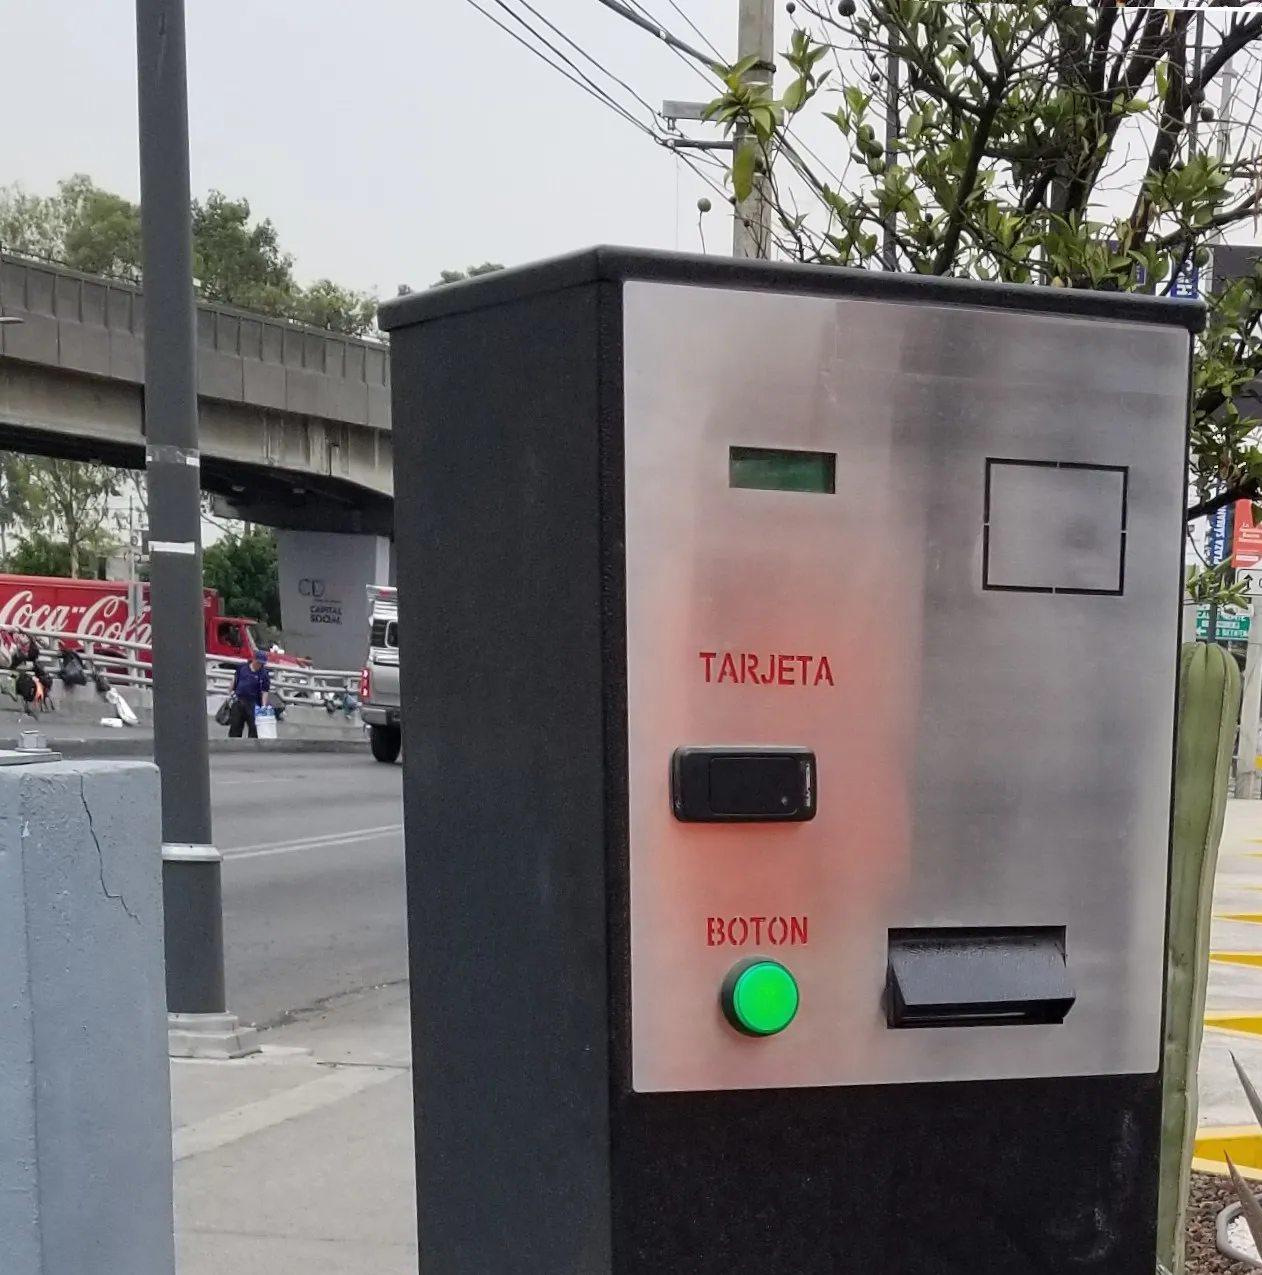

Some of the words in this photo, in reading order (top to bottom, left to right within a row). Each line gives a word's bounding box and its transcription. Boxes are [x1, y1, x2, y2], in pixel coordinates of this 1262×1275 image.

[1213, 540, 1224, 565] PLAZA
[0, 590, 152, 648] Coca-Cola
[310, 605, 342, 615] CAPITAL
[310, 614, 342, 625] SOCIAL
[699, 652, 834, 687] TARJETA
[707, 916, 808, 946] BOTON
